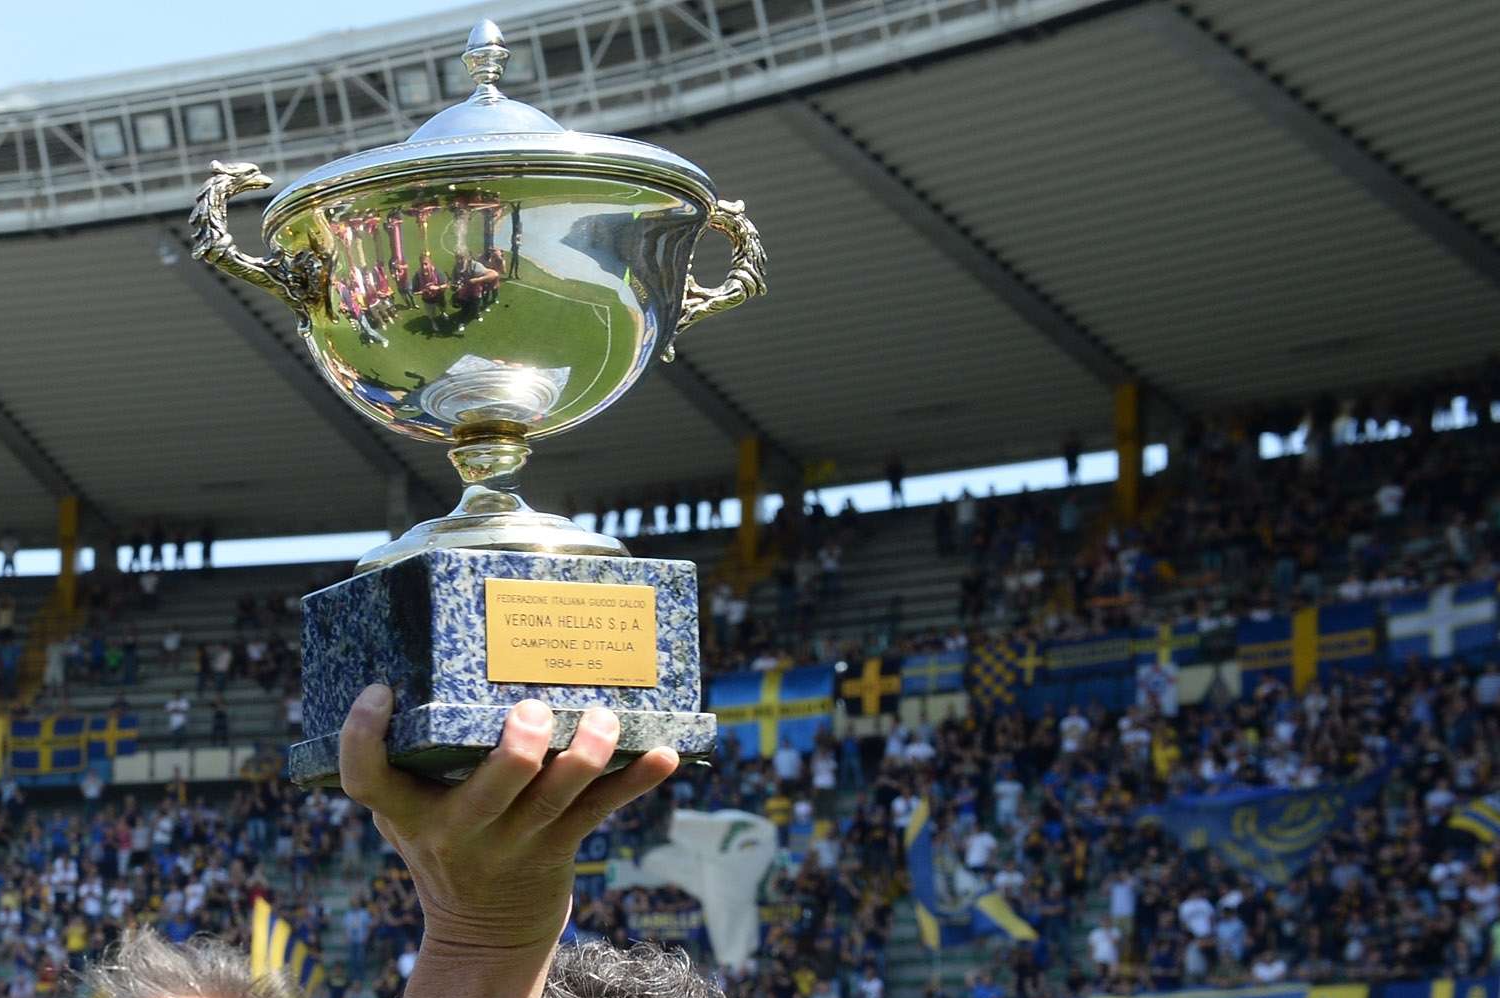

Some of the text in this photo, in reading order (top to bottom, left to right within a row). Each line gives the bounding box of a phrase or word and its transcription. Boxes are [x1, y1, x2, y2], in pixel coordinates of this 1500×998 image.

[497, 594, 645, 609] FEDERAZIONE ITALIANA GIUOCO CALCIO
[505, 613, 552, 627] VERONA
[558, 615, 602, 629] HELLAS
[511, 637, 634, 652] CAMPIONE D'ITALIA
[545, 658, 572, 669] 1984
